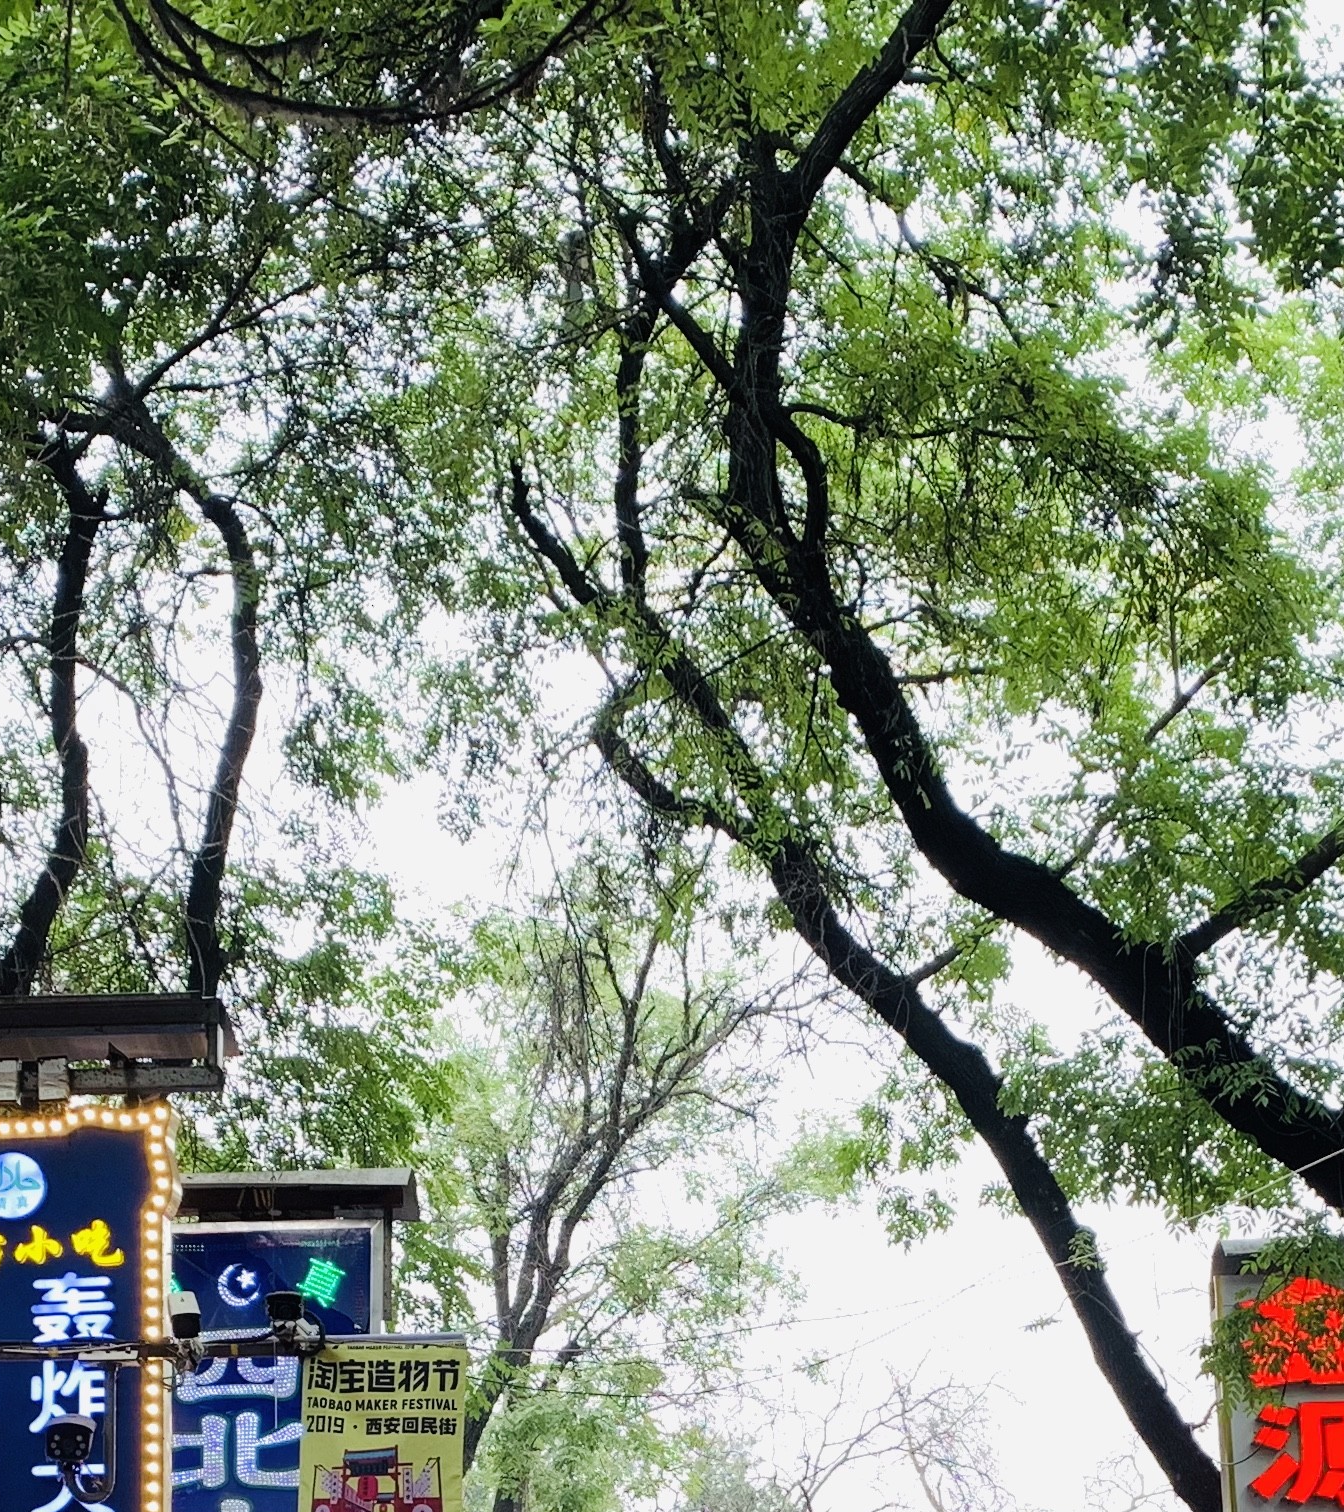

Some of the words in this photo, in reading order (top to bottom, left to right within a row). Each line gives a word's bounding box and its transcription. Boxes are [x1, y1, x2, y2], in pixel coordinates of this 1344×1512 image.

[307, 1358, 461, 1393] 淘宝造物节
[307, 1397, 352, 1412] TAOBAO
[355, 1400, 397, 1411] MAKER
[402, 1398, 458, 1411] FESTIVAL
[306, 1415, 345, 1434] 2019
[365, 1417, 457, 1436] 西安回民街
